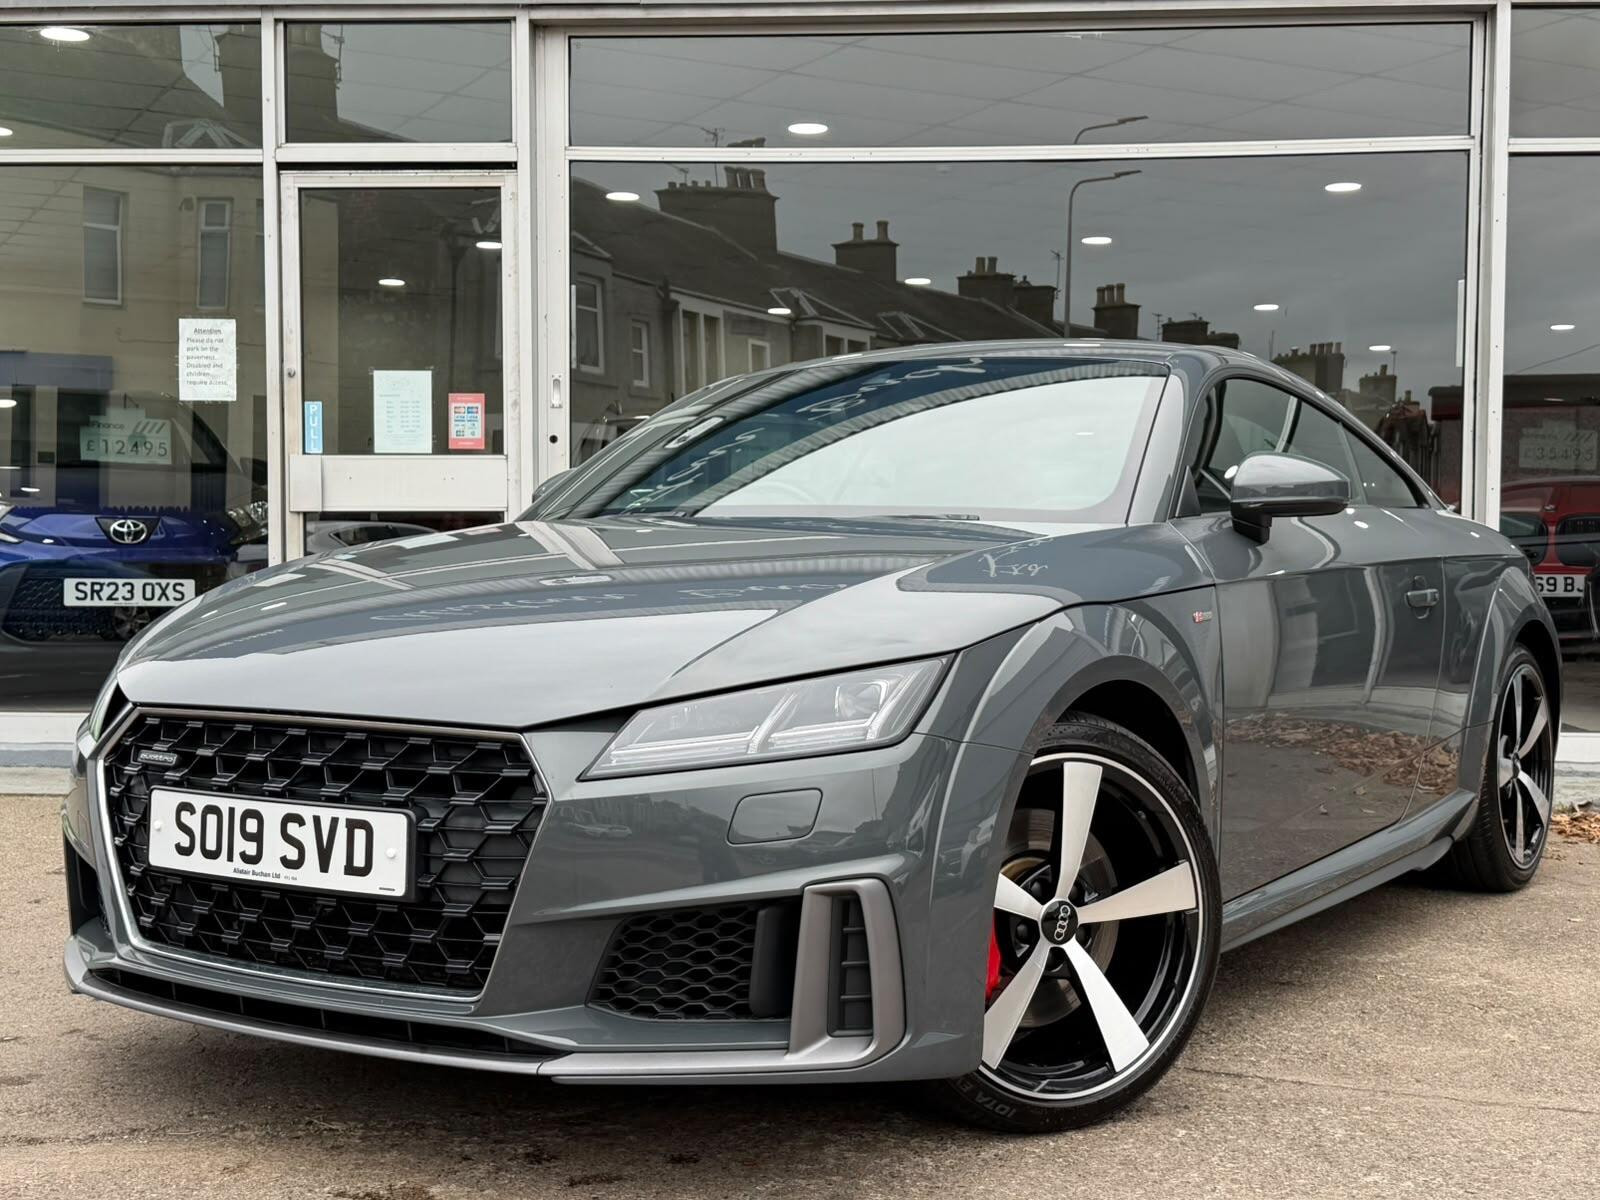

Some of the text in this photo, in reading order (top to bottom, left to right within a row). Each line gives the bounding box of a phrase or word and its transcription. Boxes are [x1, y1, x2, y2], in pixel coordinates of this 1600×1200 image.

[310, 404, 320, 450] PULL
[75, 581, 185, 601] SR23 OXS
[174, 801, 374, 877] SO19 SVD
[252, 869, 271, 878] Buchan
[271, 871, 281, 879] Ltd
